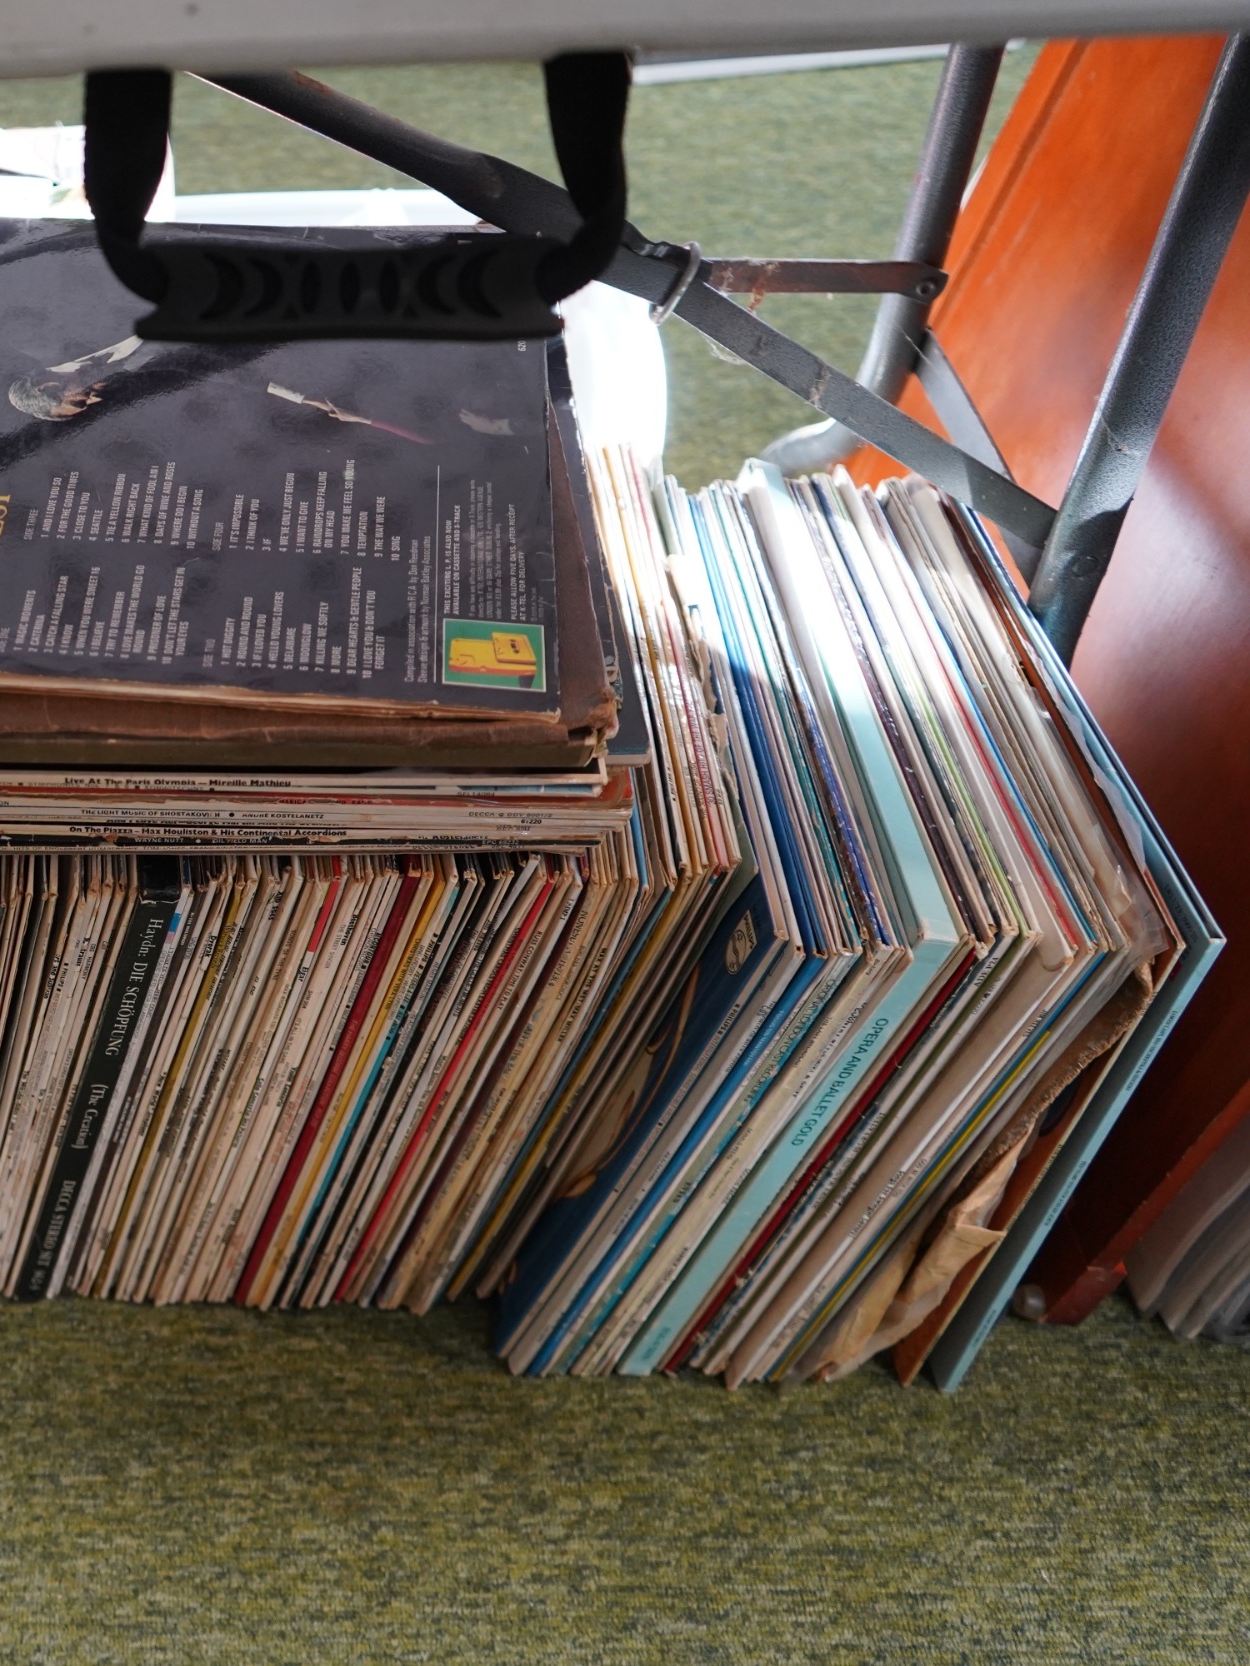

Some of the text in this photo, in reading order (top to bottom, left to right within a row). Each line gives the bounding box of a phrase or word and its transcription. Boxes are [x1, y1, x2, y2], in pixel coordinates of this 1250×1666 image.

[148, 468, 158, 478] AM
[164, 460, 175, 480] ROSES
[145, 479, 157, 493] FOOL
[161, 481, 172, 493] AND
[41, 477, 62, 531] AND LOVE YOU SO
[57, 470, 80, 532] FOR THE GOOD TIMES
[79, 491, 91, 504] YOU
[108, 496, 122, 519] YELLOW
[159, 494, 170, 510] WINE
[279, 471, 295, 545] WE'VE ONLY JUST BEGUN
[298, 500, 308, 514] GIVE
[340, 459, 355, 547] YOU MAKE ME FEEL SO YOUNG
[122, 482, 140, 536] WALK RIGHT BACK
[141, 503, 153, 517] KIND
[171, 485, 188, 538] WHERE DO BEGIN
[188, 488, 203, 539] WITHOUT SONG
[229, 493, 244, 542] IT'S IMPOSSIBLE
[246, 498, 259, 539] THINK OF YOU
[313, 471, 327, 546] RAINDROPS KEEP FALLING
[23, 508, 39, 539] SIDE THREE
[73, 514, 86, 533] CLOSE
[89, 509, 102, 534] SEATTLE
[106, 525, 117, 534] TIE
[138, 518, 150, 536] WHAT
[154, 520, 166, 536] DAYS
[324, 510, 334, 547] ON MY HEAD
[357, 510, 368, 549] TEMPTATION
[373, 495, 385, 550] THE WAY WE WERE
[212, 522, 224, 550] SIDE FOUR
[296, 524, 306, 542] WANT
[391, 535, 400, 551] SING
[65, 777, 84, 785] Live
[88, 777, 100, 785] At
[104, 778, 123, 786] The
[209, 779, 247, 787] Mireille
[341, 914, 358, 945] Beethoven
[530, 931, 542, 944] RUSS
[204, 935, 218, 956] Dvorak
[422, 940, 435, 962] PHILIPS
[597, 948, 606, 961] MAX
[296, 967, 308, 981] Elgar
[592, 964, 599, 972] AT
[106, 919, 162, 1055] Haydn: DIE SCHÖPFUNG
[508, 974, 519, 986] TIME
[585, 976, 594, 987] THE
[496, 996, 507, 1009] PLAY
[570, 1005, 580, 1019] MAX
[720, 1009, 737, 1030] PHILIPS
[558, 1021, 572, 1042] MILLER
[791, 1018, 888, 1145] OPERA AND BALLET GOLD
[88, 1084, 108, 1105] (The
[72, 1109, 98, 1149] Creation)
